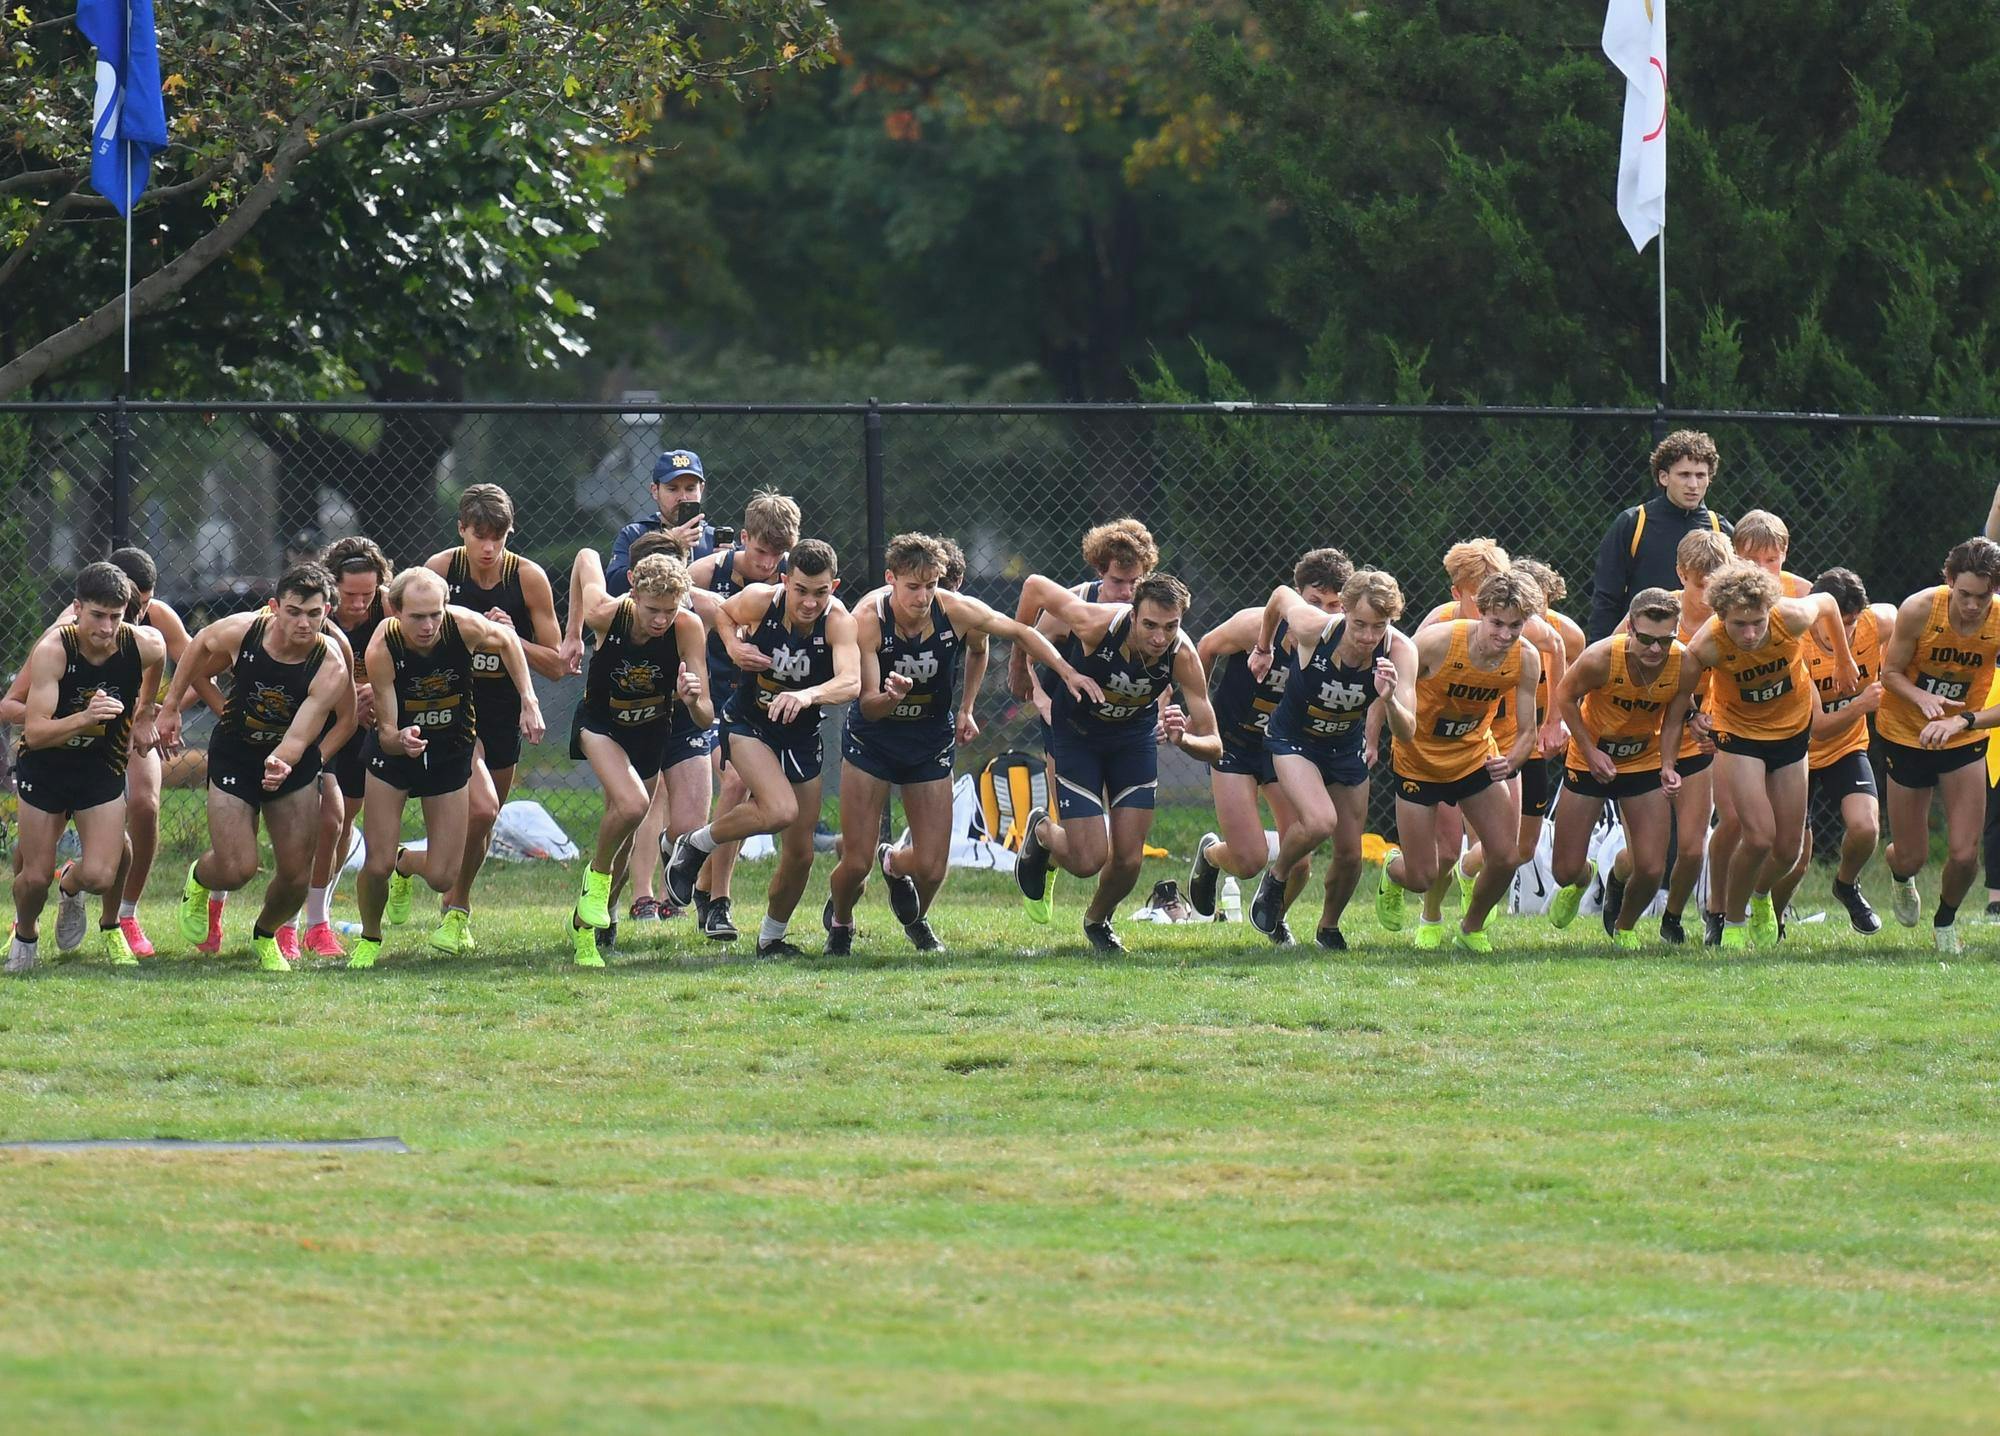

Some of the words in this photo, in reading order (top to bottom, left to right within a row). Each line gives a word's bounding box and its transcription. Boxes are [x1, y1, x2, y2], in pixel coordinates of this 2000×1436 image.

[472, 654, 500, 671] 69
[1930, 647, 1983, 667] IOWA
[1735, 657, 1788, 682] IOWA
[1814, 664, 1869, 691] IOA
[1447, 683, 1500, 702] IOWA
[1749, 681, 1784, 702] 187
[1926, 679, 1963, 698] 188
[413, 709, 452, 726] 466
[618, 705, 656, 721] 472
[890, 705, 922, 717] 80
[1100, 703, 1140, 718] 287
[1312, 719, 1351, 733] 285
[66, 735, 95, 748] 67
[250, 731, 287, 742] 47
[1606, 743, 1643, 757] 190
